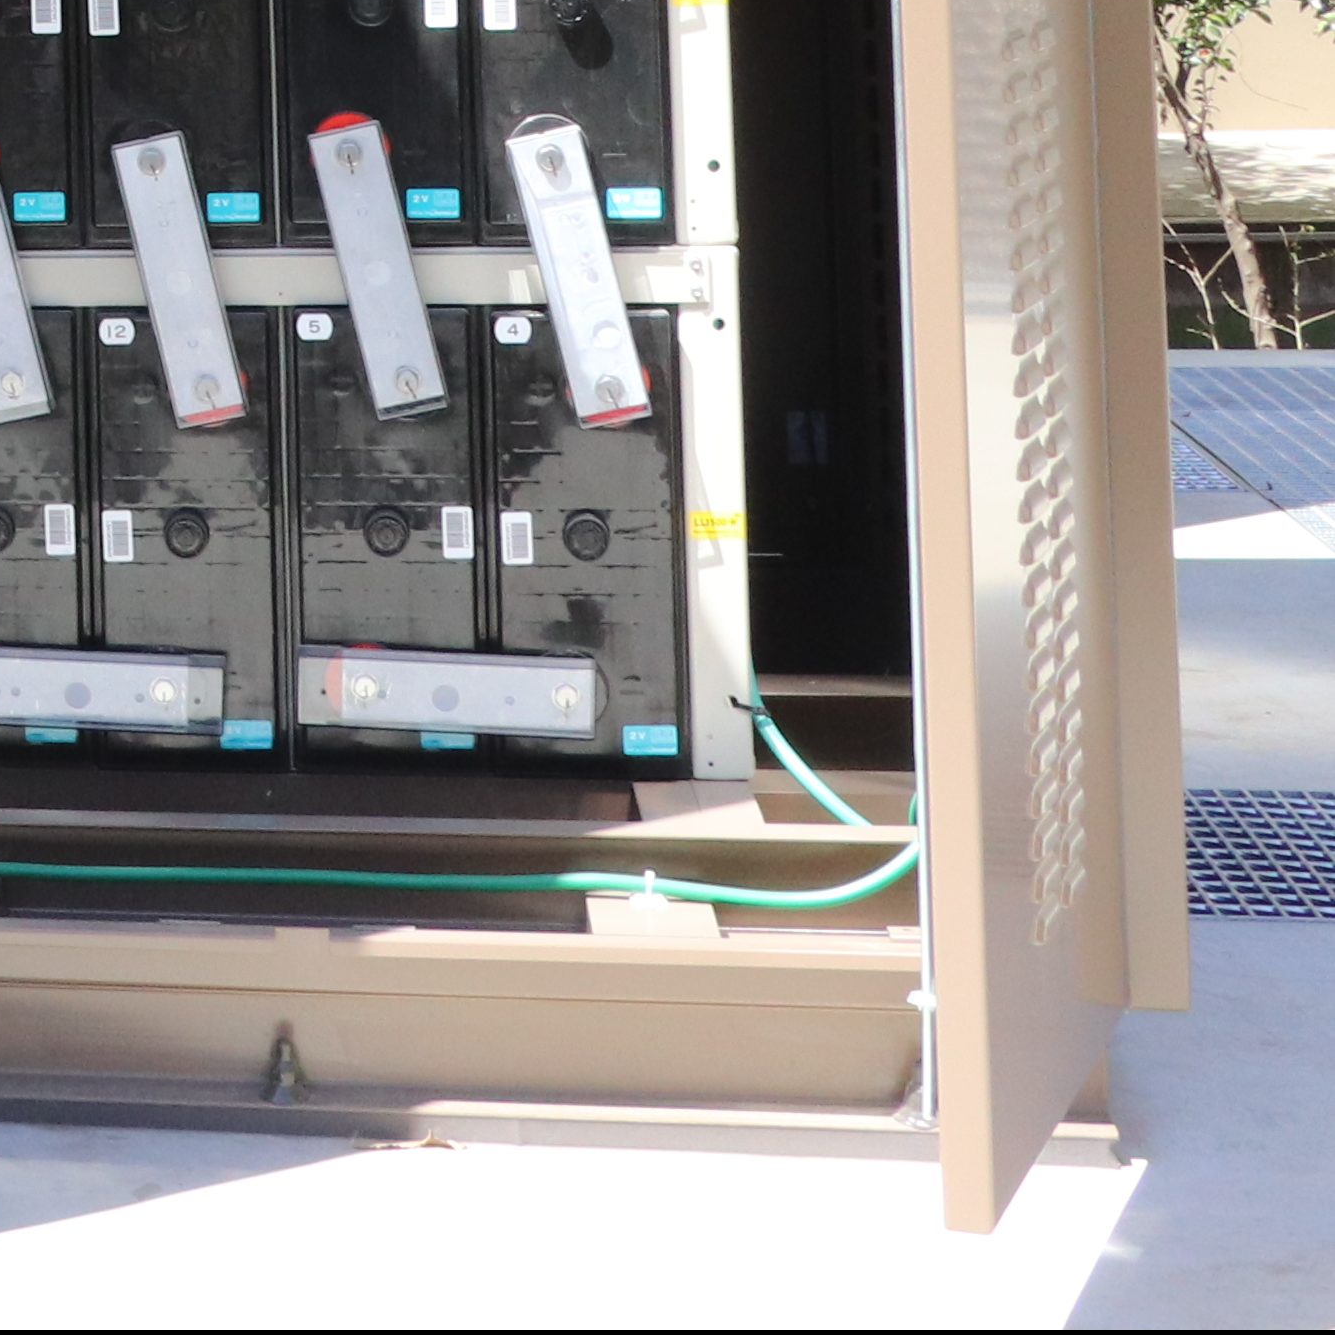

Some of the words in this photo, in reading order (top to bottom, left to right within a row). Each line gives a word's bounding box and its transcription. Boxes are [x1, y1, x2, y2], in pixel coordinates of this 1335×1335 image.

[107, 324, 127, 339] 12
[308, 320, 321, 334] 5
[507, 323, 519, 336] 4
